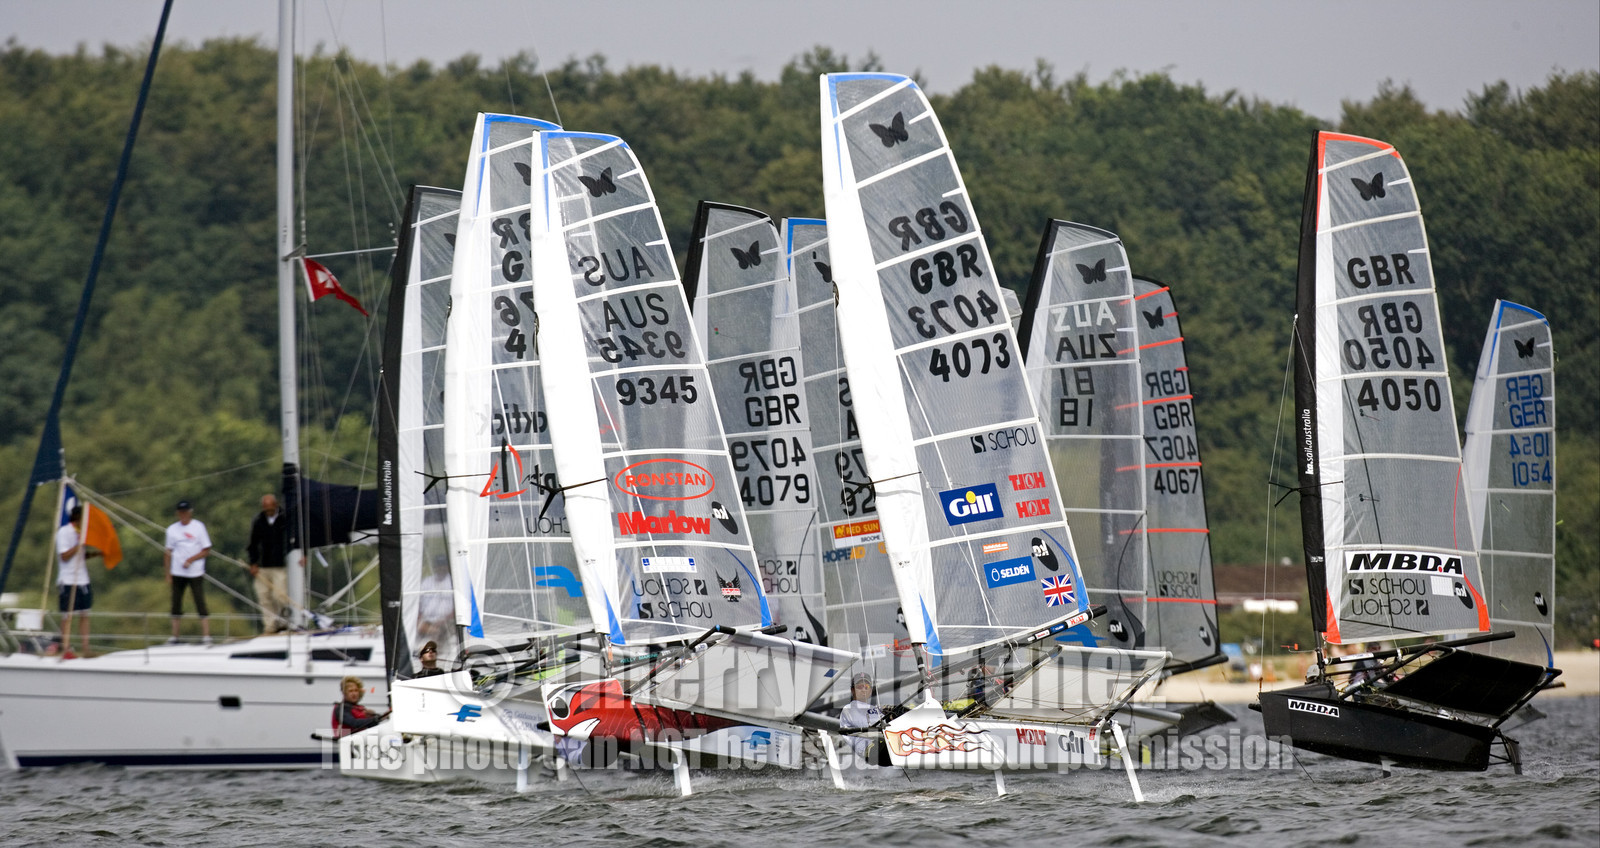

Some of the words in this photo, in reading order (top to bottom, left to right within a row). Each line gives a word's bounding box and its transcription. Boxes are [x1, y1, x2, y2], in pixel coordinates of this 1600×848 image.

[910, 243, 983, 295] GBR
[1346, 252, 1415, 289] GBR
[604, 292, 669, 332] AUS
[929, 333, 1011, 382] 4073
[616, 376, 698, 406] 9345
[1357, 378, 1442, 413] 4050
[744, 393, 801, 427] GBR
[1153, 401, 1192, 430] GBR
[1509, 400, 1547, 428] GER
[988, 426, 1037, 451] SCHOU
[625, 472, 707, 488] RONSTAN
[1154, 468, 1199, 495] 4067
[1512, 461, 1552, 486] 1054
[740, 474, 809, 507] 4079
[949, 490, 994, 518] Gill
[1016, 498, 1051, 519] HOLT
[618, 510, 710, 535] Marlow
[845, 525, 861, 535] RED
[863, 523, 879, 532] SUN
[1000, 564, 1030, 578] SELDÉN
[763, 578, 798, 593] CHOU
[1170, 584, 1199, 598] SCHOU
[1370, 577, 1426, 595] SCHOU
[659, 602, 713, 619] SCHOU
[1016, 728, 1046, 746] HOLT
[1058, 731, 1084, 754] Gill
